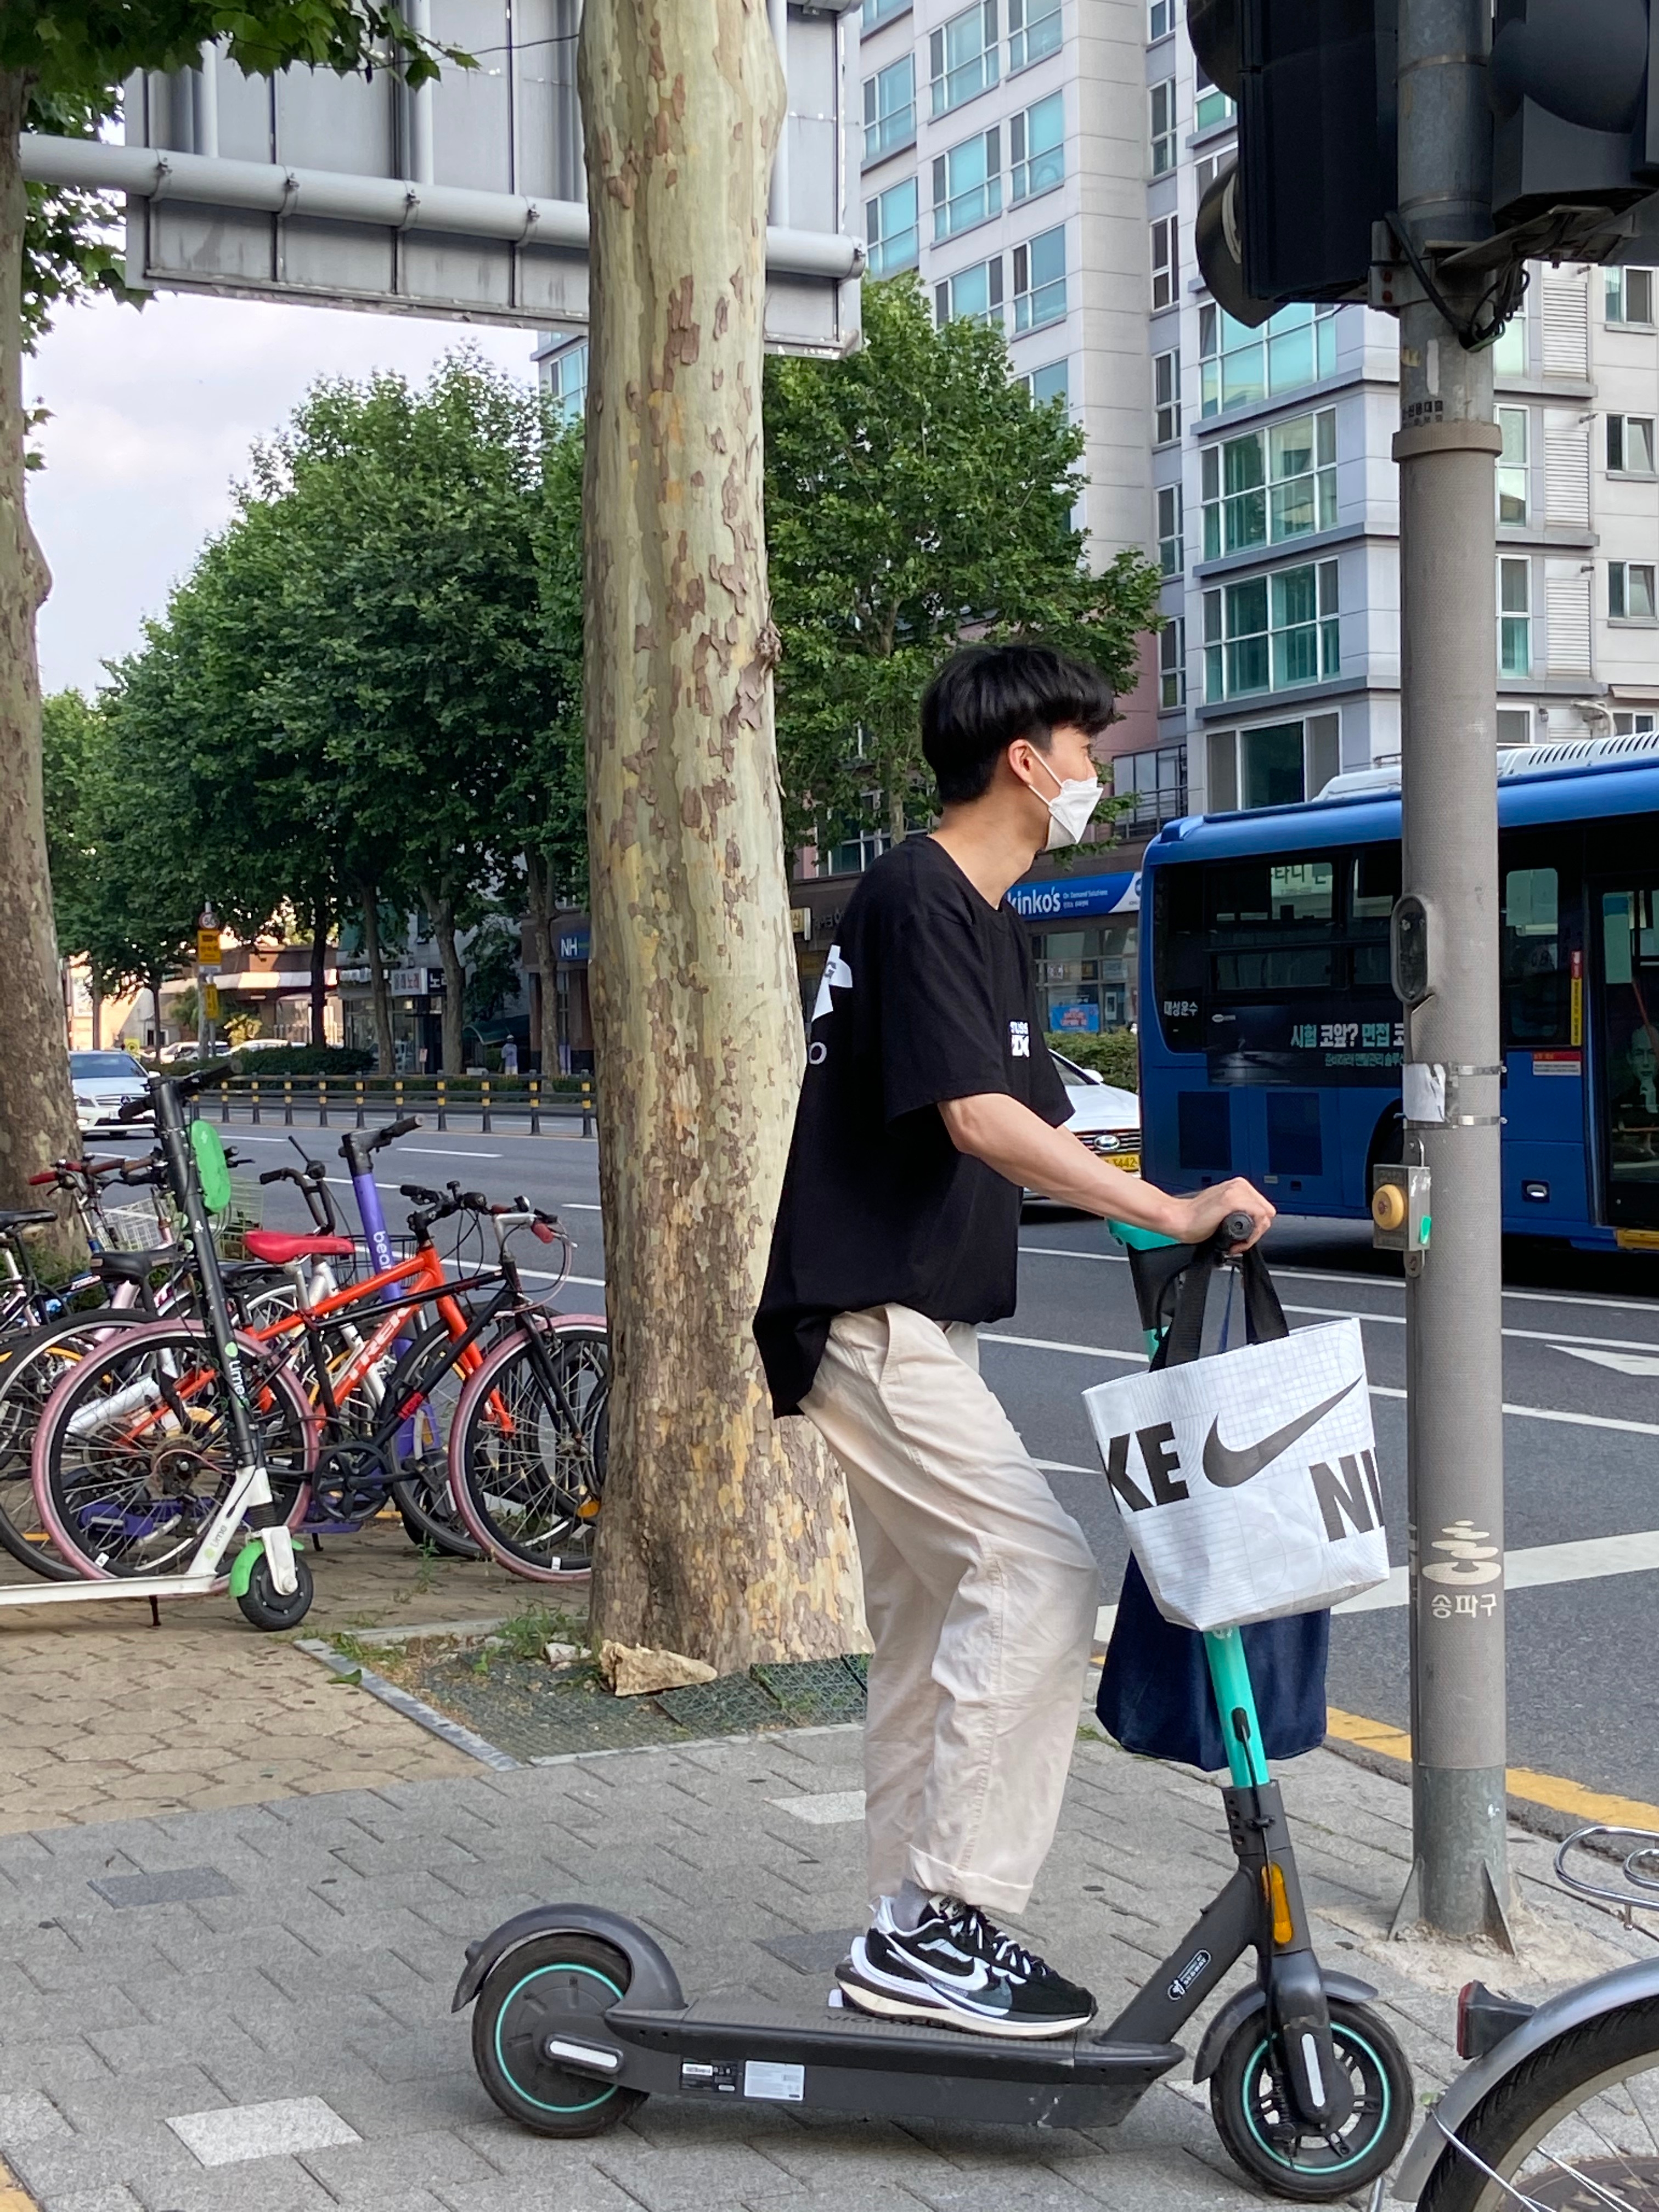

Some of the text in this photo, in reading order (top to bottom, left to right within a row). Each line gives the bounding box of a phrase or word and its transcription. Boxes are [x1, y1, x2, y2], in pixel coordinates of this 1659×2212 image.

[560, 938, 577, 957] NH
[1164, 1001, 1198, 1017] 대성운수
[1290, 1024, 1317, 1048] 시험
[1319, 1023, 1358, 1048] 코앞?
[1362, 1023, 1390, 1047] 면접
[229, 1359, 245, 1396] Lime
[1097, 1421, 1189, 1513] KE
[1431, 1593, 1497, 1619] 송파구
